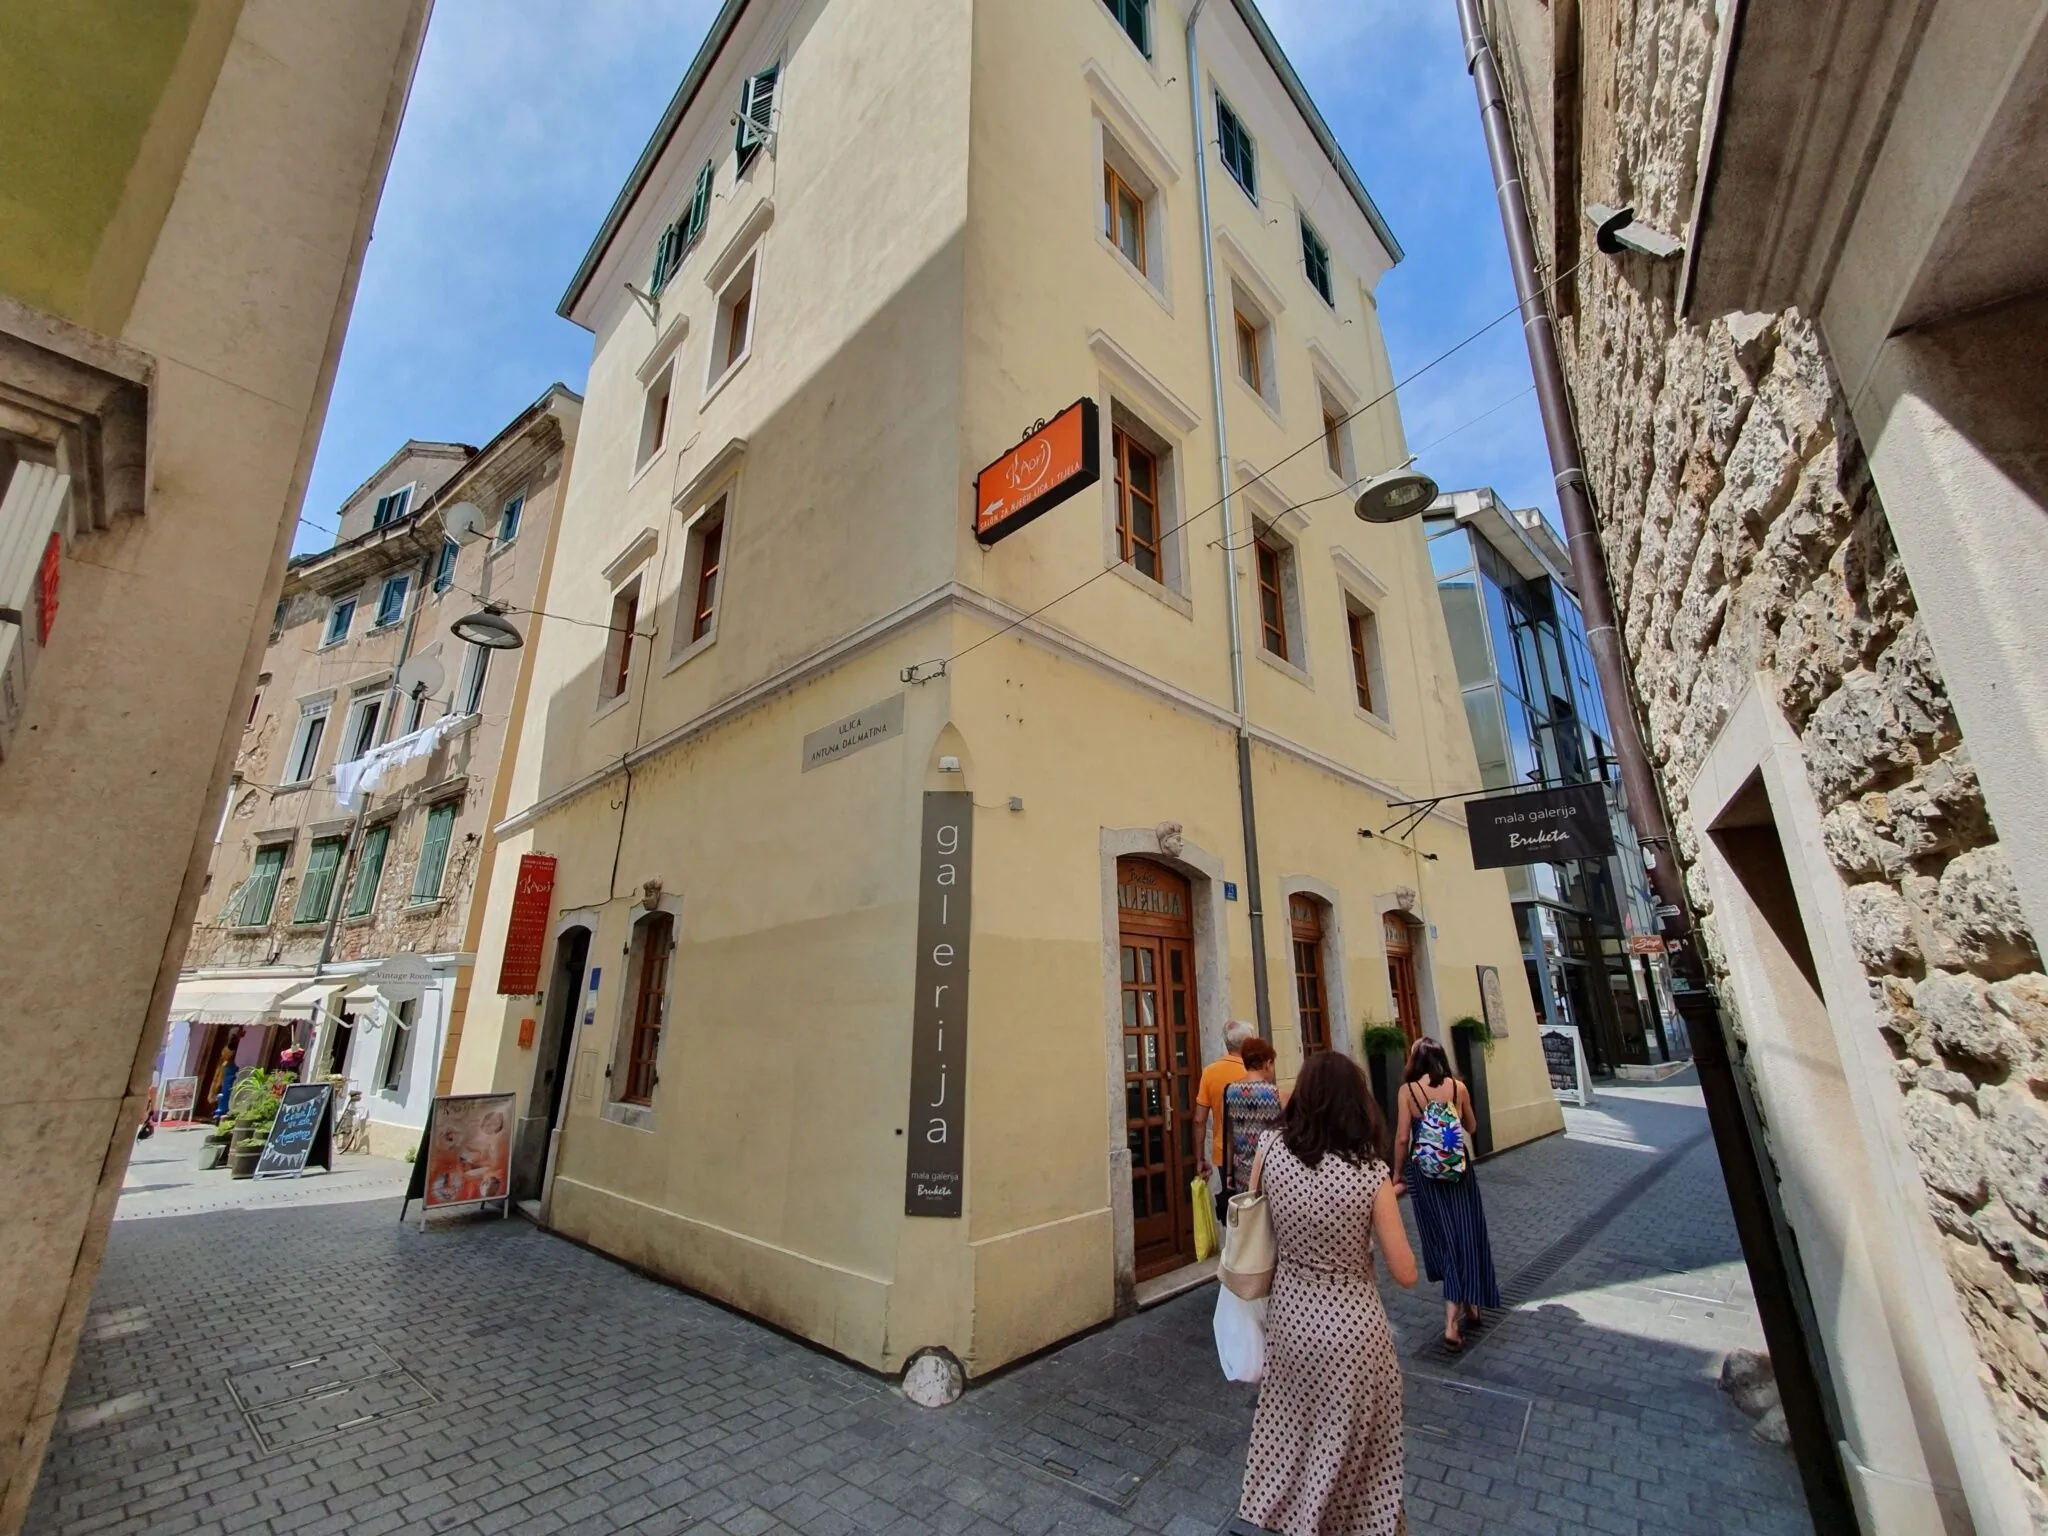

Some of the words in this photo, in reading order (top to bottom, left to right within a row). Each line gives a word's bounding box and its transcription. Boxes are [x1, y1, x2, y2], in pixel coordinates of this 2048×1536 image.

[839, 718, 862, 735] ULICA
[811, 744, 839, 760] ANTUNA
[842, 724, 887, 748] DALMATINA
[1494, 811, 1525, 825] mala
[1528, 805, 1577, 823] galerija
[1508, 828, 1570, 849] Bruketa
[1117, 883, 1180, 914] ALERIJA
[376, 972, 408, 981] Vintage
[409, 972, 432, 980] Room
[926, 824, 959, 1145] galerija
[911, 1171, 930, 1180] mala
[931, 1171, 959, 1183] galerija
[917, 1184, 952, 1196] Bruketa
